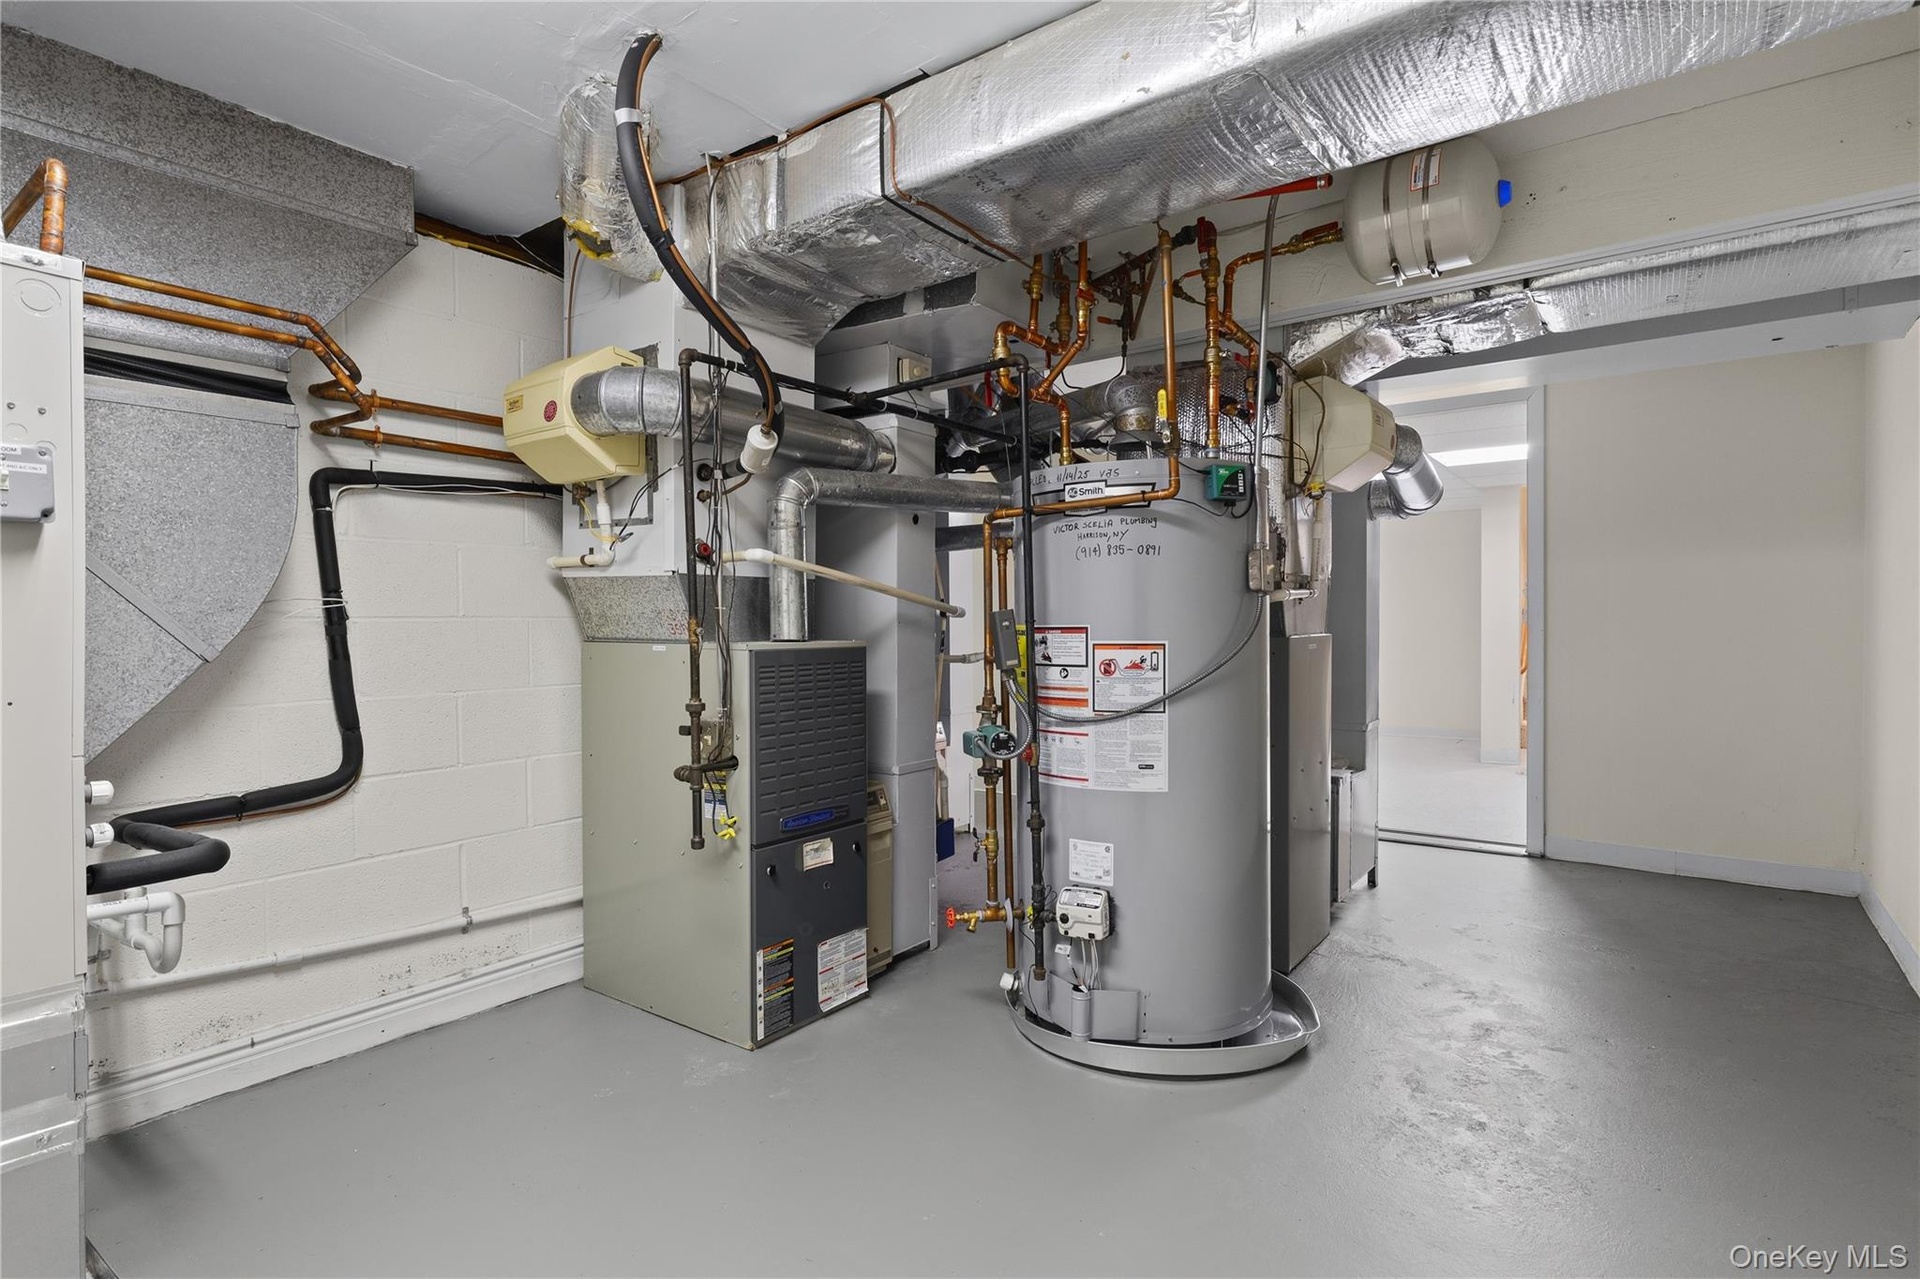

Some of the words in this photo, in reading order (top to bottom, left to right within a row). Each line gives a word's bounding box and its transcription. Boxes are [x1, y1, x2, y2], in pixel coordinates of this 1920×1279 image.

[1079, 487, 1104, 496] Smith
[1053, 523, 1080, 534] VICTOR
[1113, 529, 1129, 541] NY
[1075, 543, 1101, 561] (914)
